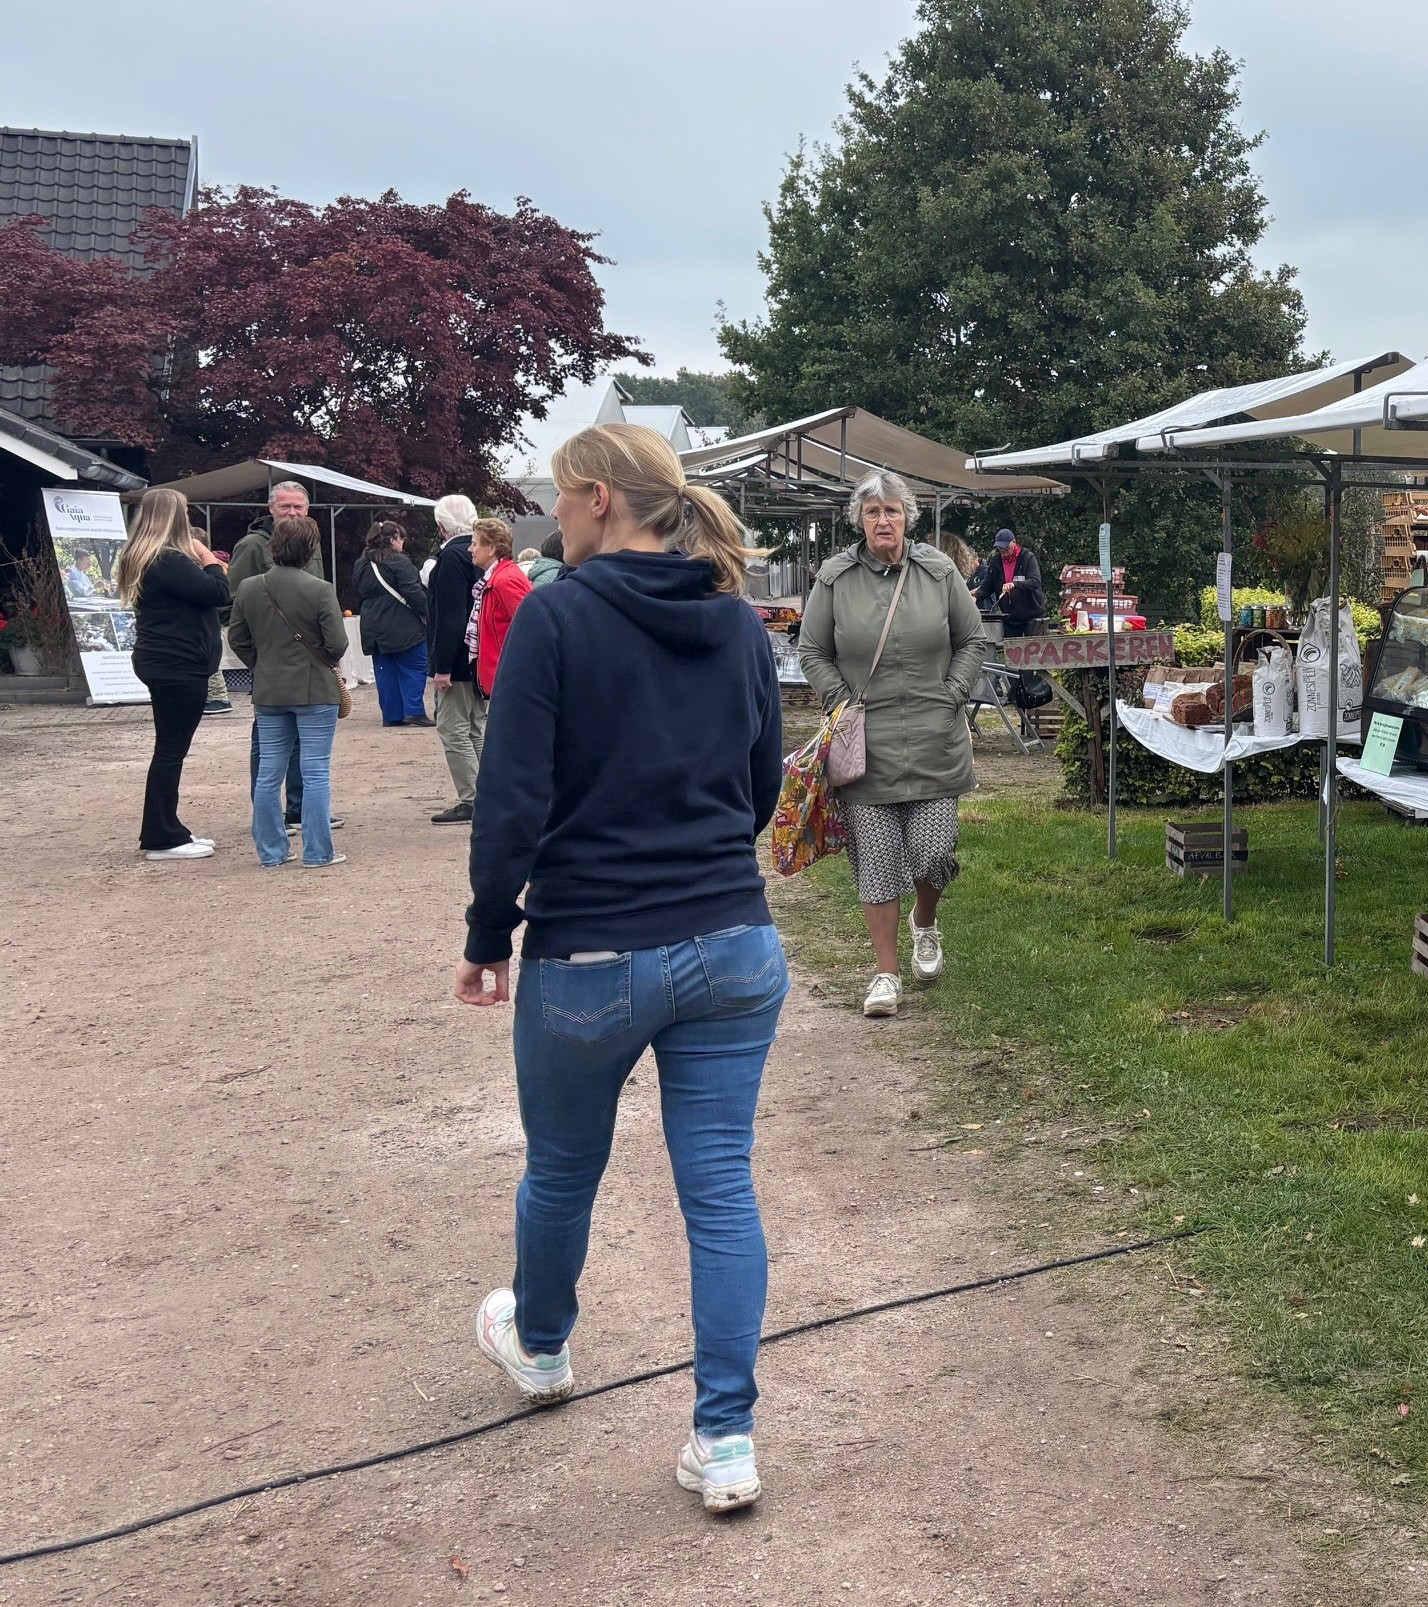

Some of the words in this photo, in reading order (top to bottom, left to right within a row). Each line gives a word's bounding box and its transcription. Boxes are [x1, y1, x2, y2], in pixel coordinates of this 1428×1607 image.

[61, 503, 84, 514] Gaia
[69, 513, 91, 524] Aqua
[1023, 634, 1175, 666] PARKEREN
[1305, 667, 1317, 712] ZONNESPELT
[1187, 851, 1238, 860] AFVALBK
